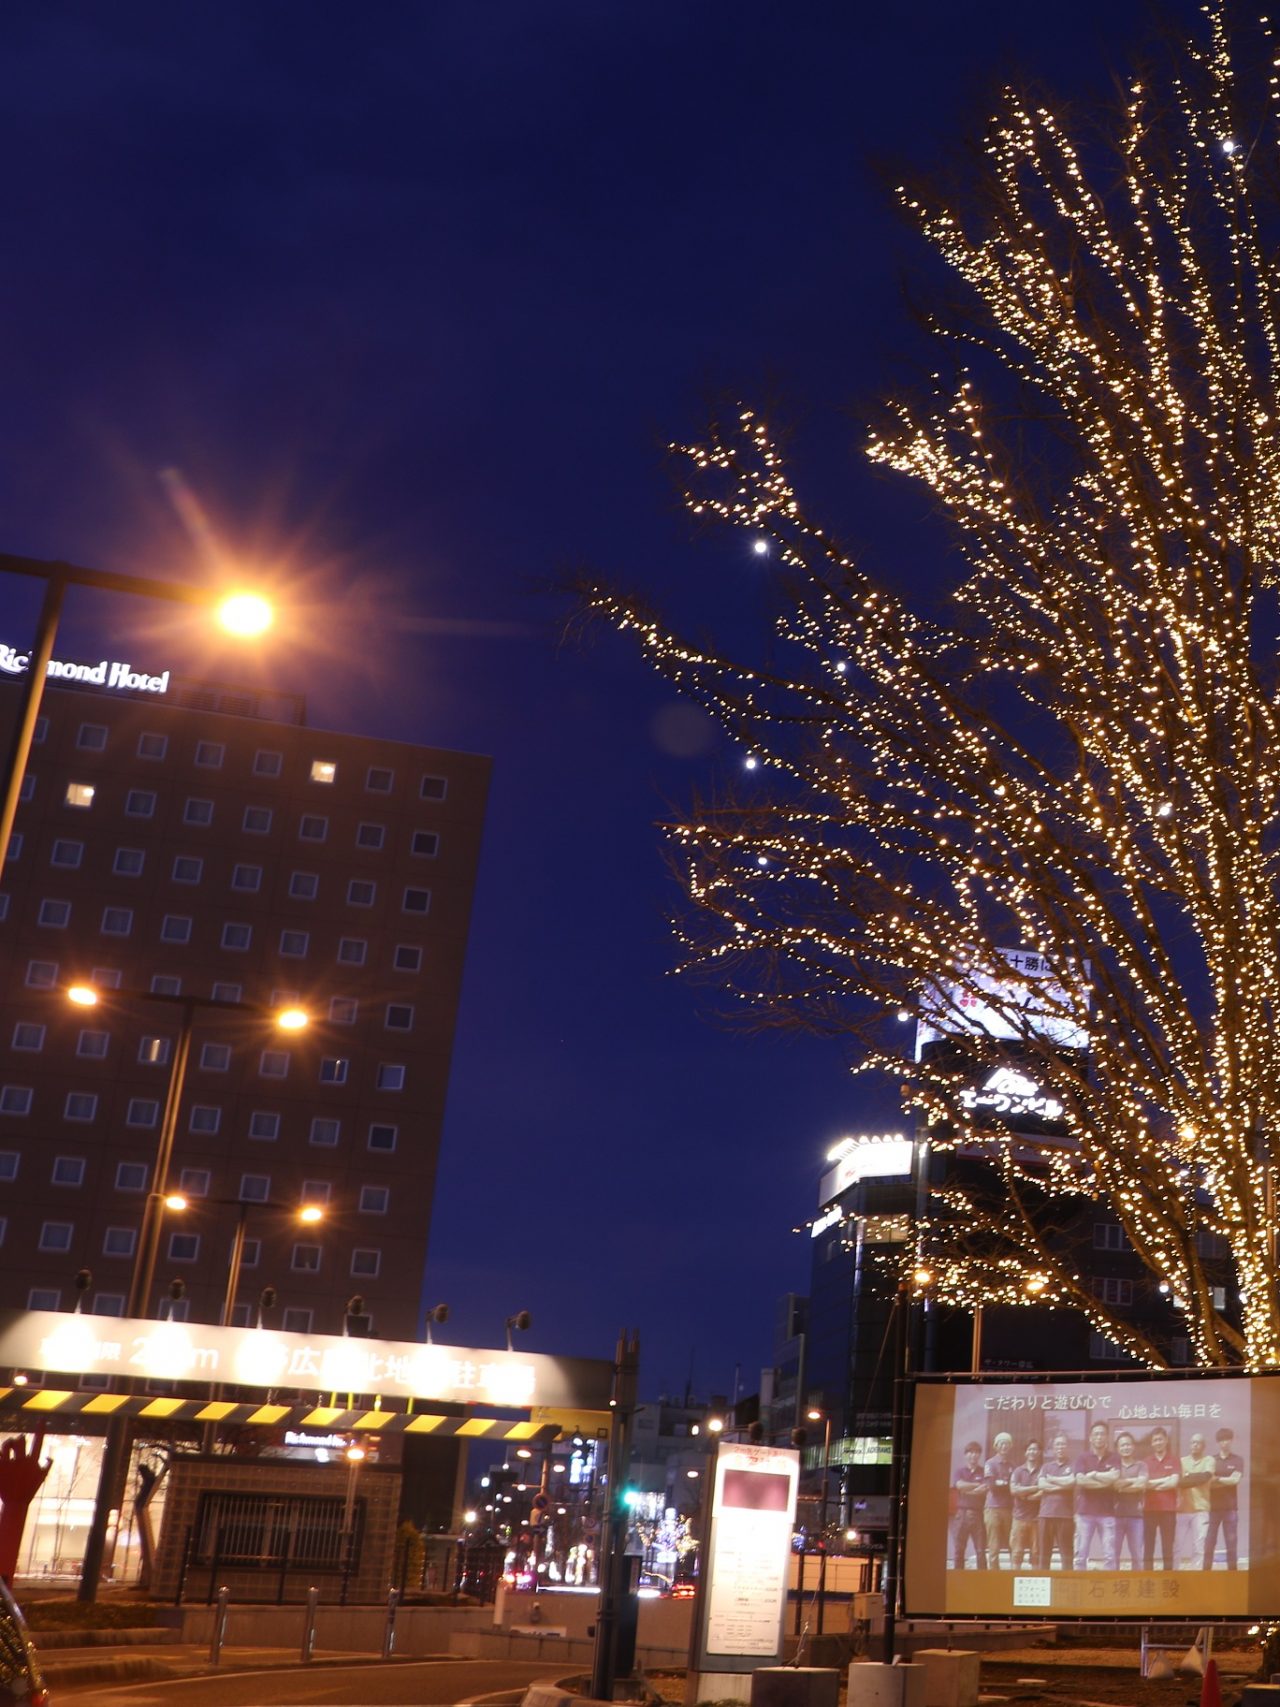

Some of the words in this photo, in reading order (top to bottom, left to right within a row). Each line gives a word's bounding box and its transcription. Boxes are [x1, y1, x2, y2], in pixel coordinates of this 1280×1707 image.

[0, 644, 108, 684] Ricmond
[108, 662, 170, 693] Hotel
[982, 1394, 1112, 1411] こだわりと遊び心で
[1117, 1402, 1222, 1419] 心地よい毎日を
